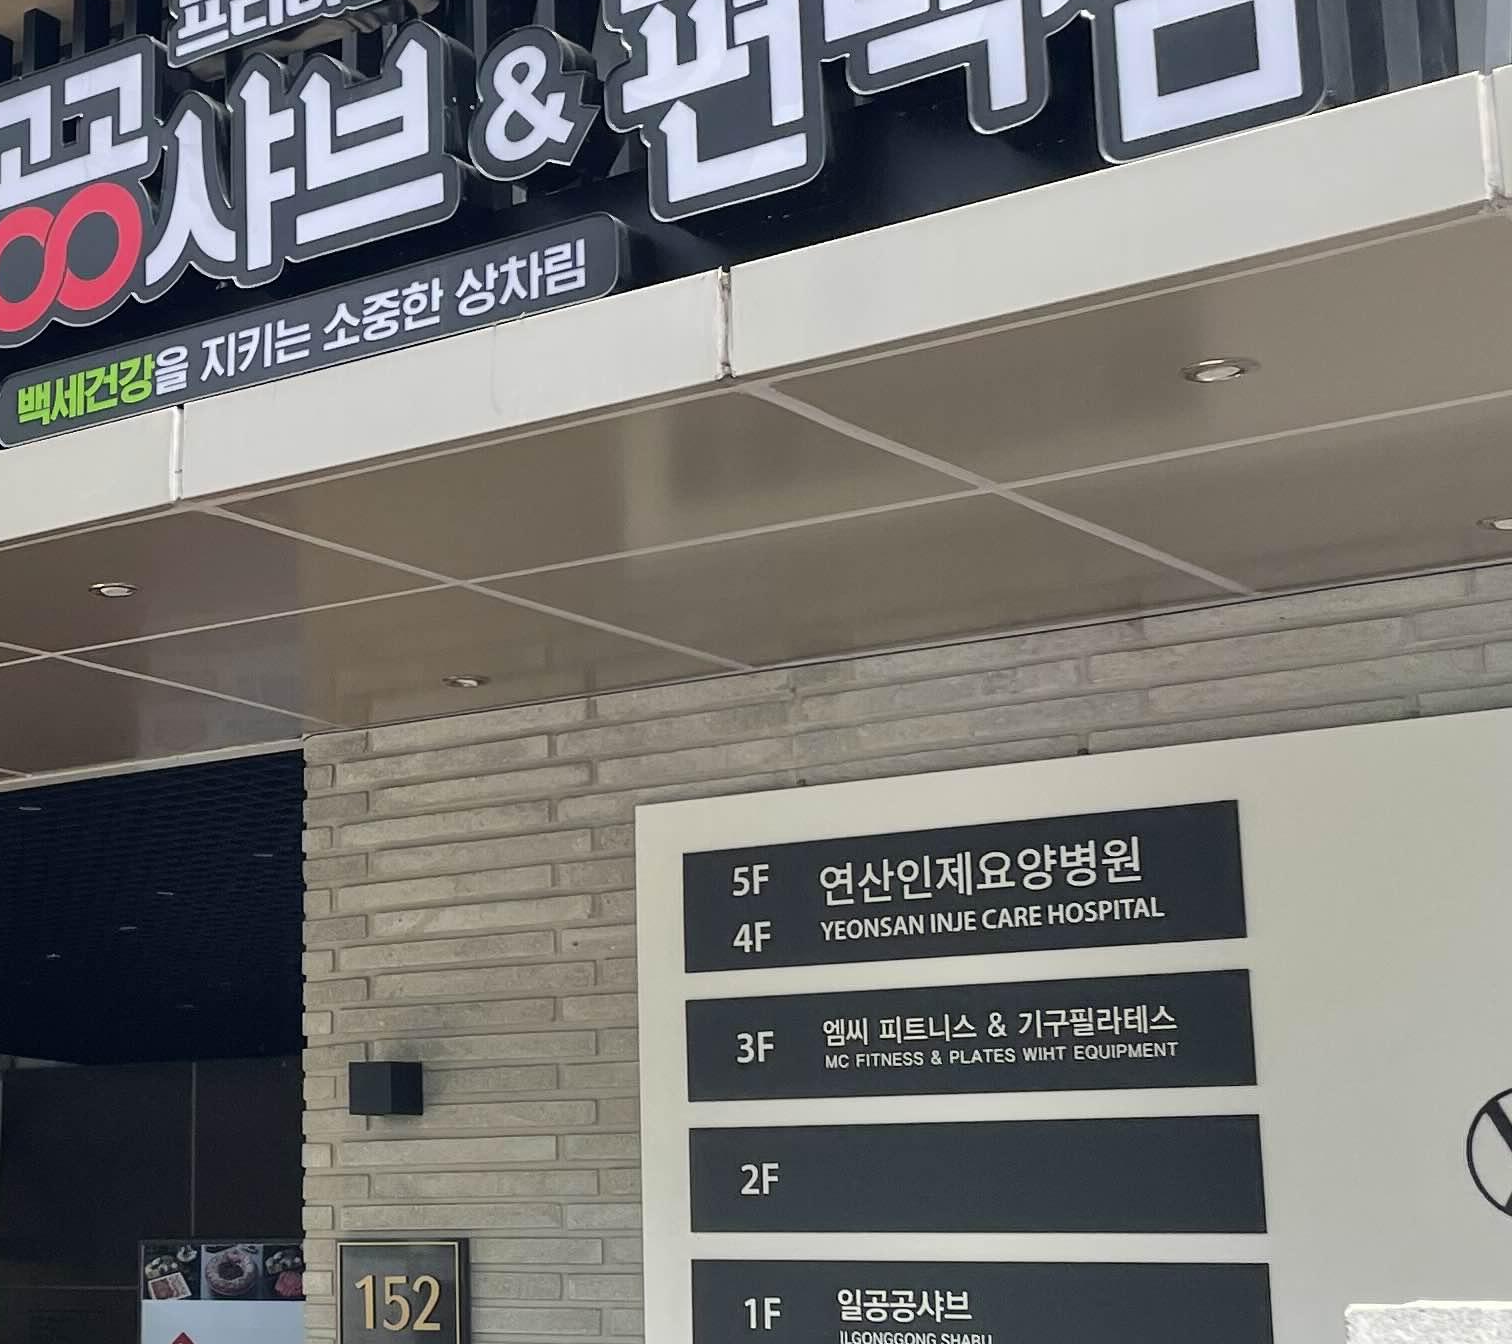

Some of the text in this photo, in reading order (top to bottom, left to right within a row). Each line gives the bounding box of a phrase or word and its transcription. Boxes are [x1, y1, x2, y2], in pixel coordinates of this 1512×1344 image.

[483, 44, 576, 163] &
[16, 238, 587, 426] 백세건강을 지키는 소중한 상차림
[733, 864, 768, 896] 5F
[819, 836, 1142, 907] 연산인제요양병원
[821, 897, 1165, 940] YEONSAN INJE CARE HOSPITAL
[734, 921, 770, 952] 4F
[823, 1005, 1177, 1046] 엠씨 피트니스 & 기구필라테스
[737, 1031, 773, 1063] 3F
[826, 1042, 1178, 1068] MC FITNESS & PLATES WIHT EQUIPMENT
[741, 1163, 778, 1194] 2F
[354, 1273, 442, 1332] 152
[745, 1298, 780, 1329] 1F
[838, 1289, 972, 1322] 일공공샤브
